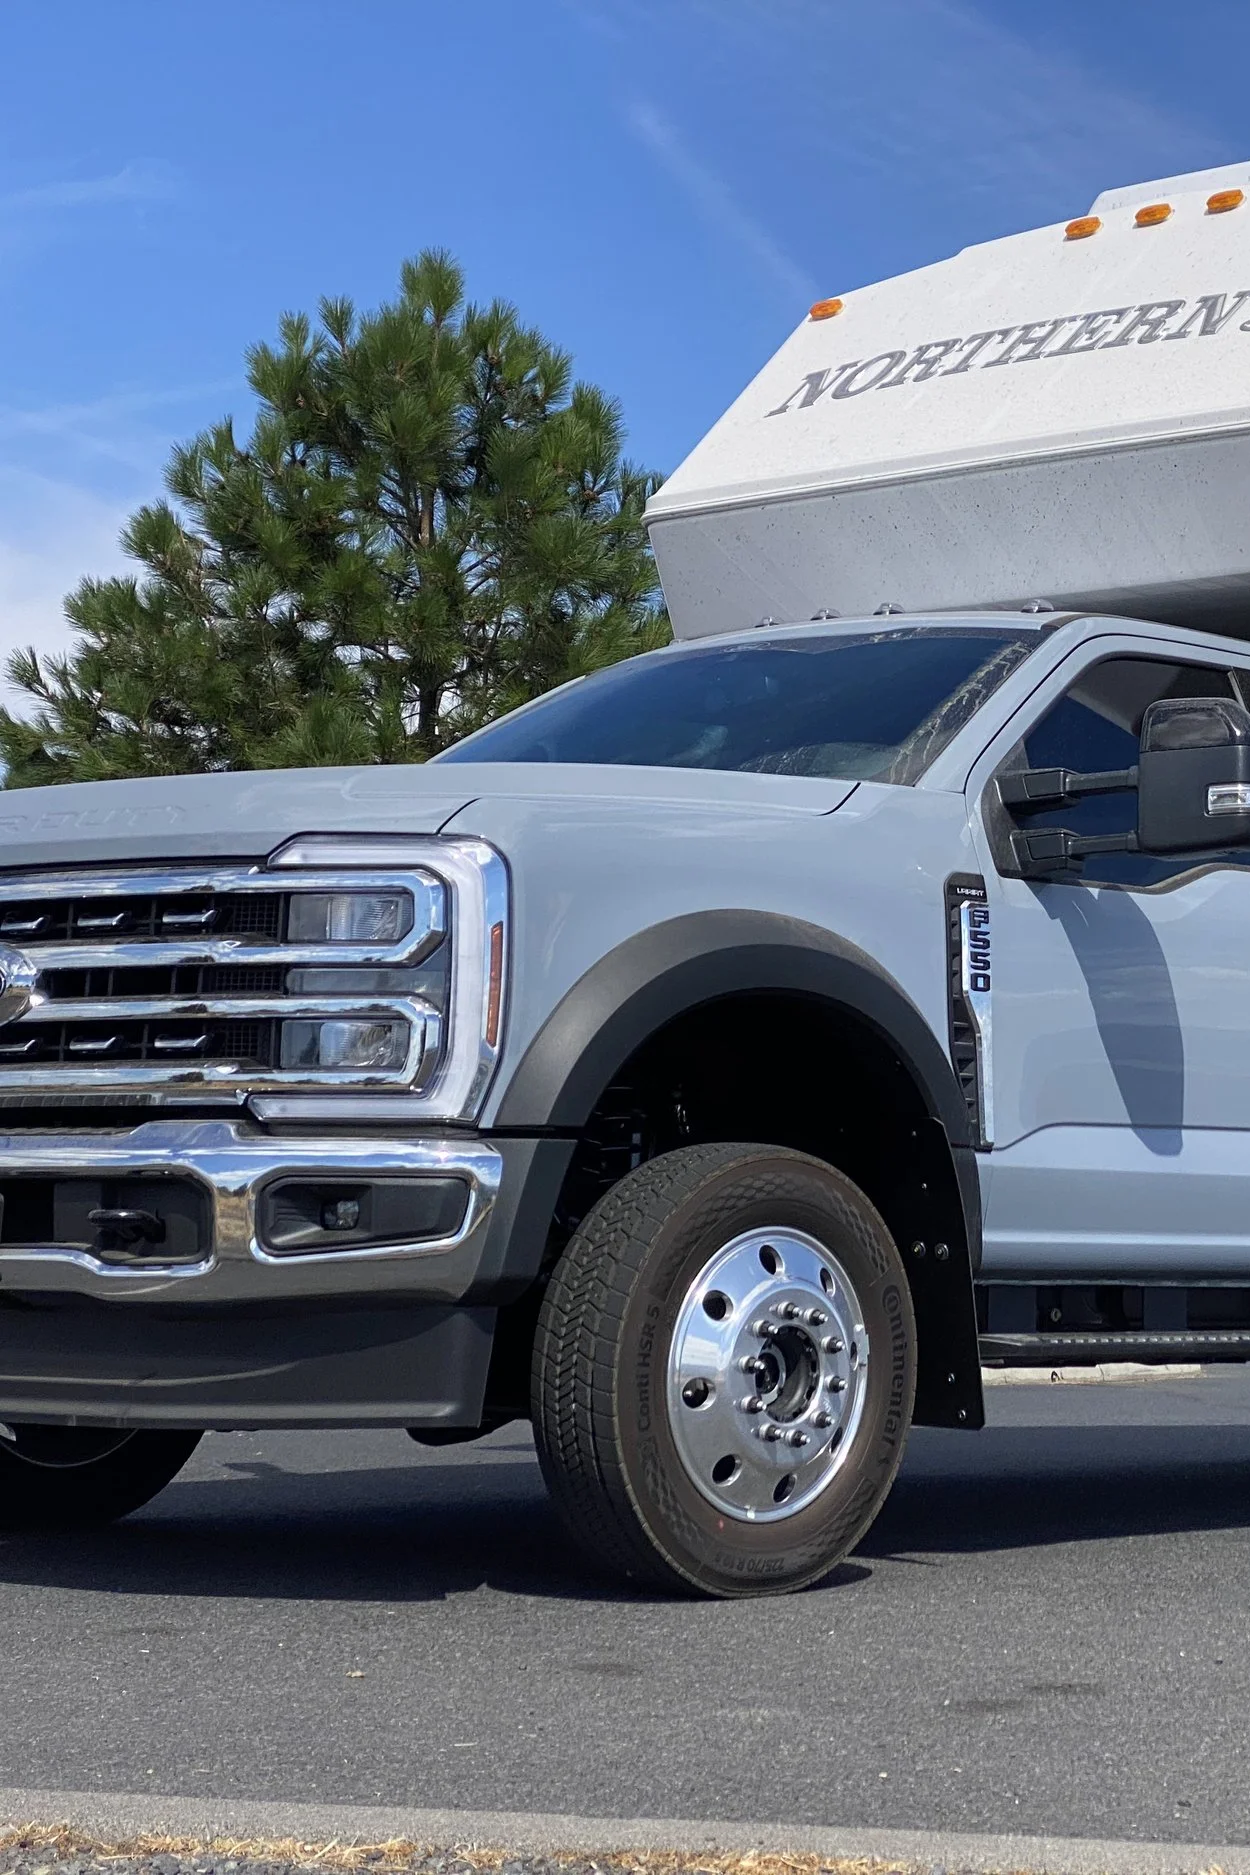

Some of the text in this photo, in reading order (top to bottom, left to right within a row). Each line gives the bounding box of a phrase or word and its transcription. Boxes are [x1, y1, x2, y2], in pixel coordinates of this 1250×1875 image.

[637, 1321, 657, 1368] HSR
[882, 1284, 908, 1447] Continental
[636, 1373, 652, 1433] Conti
